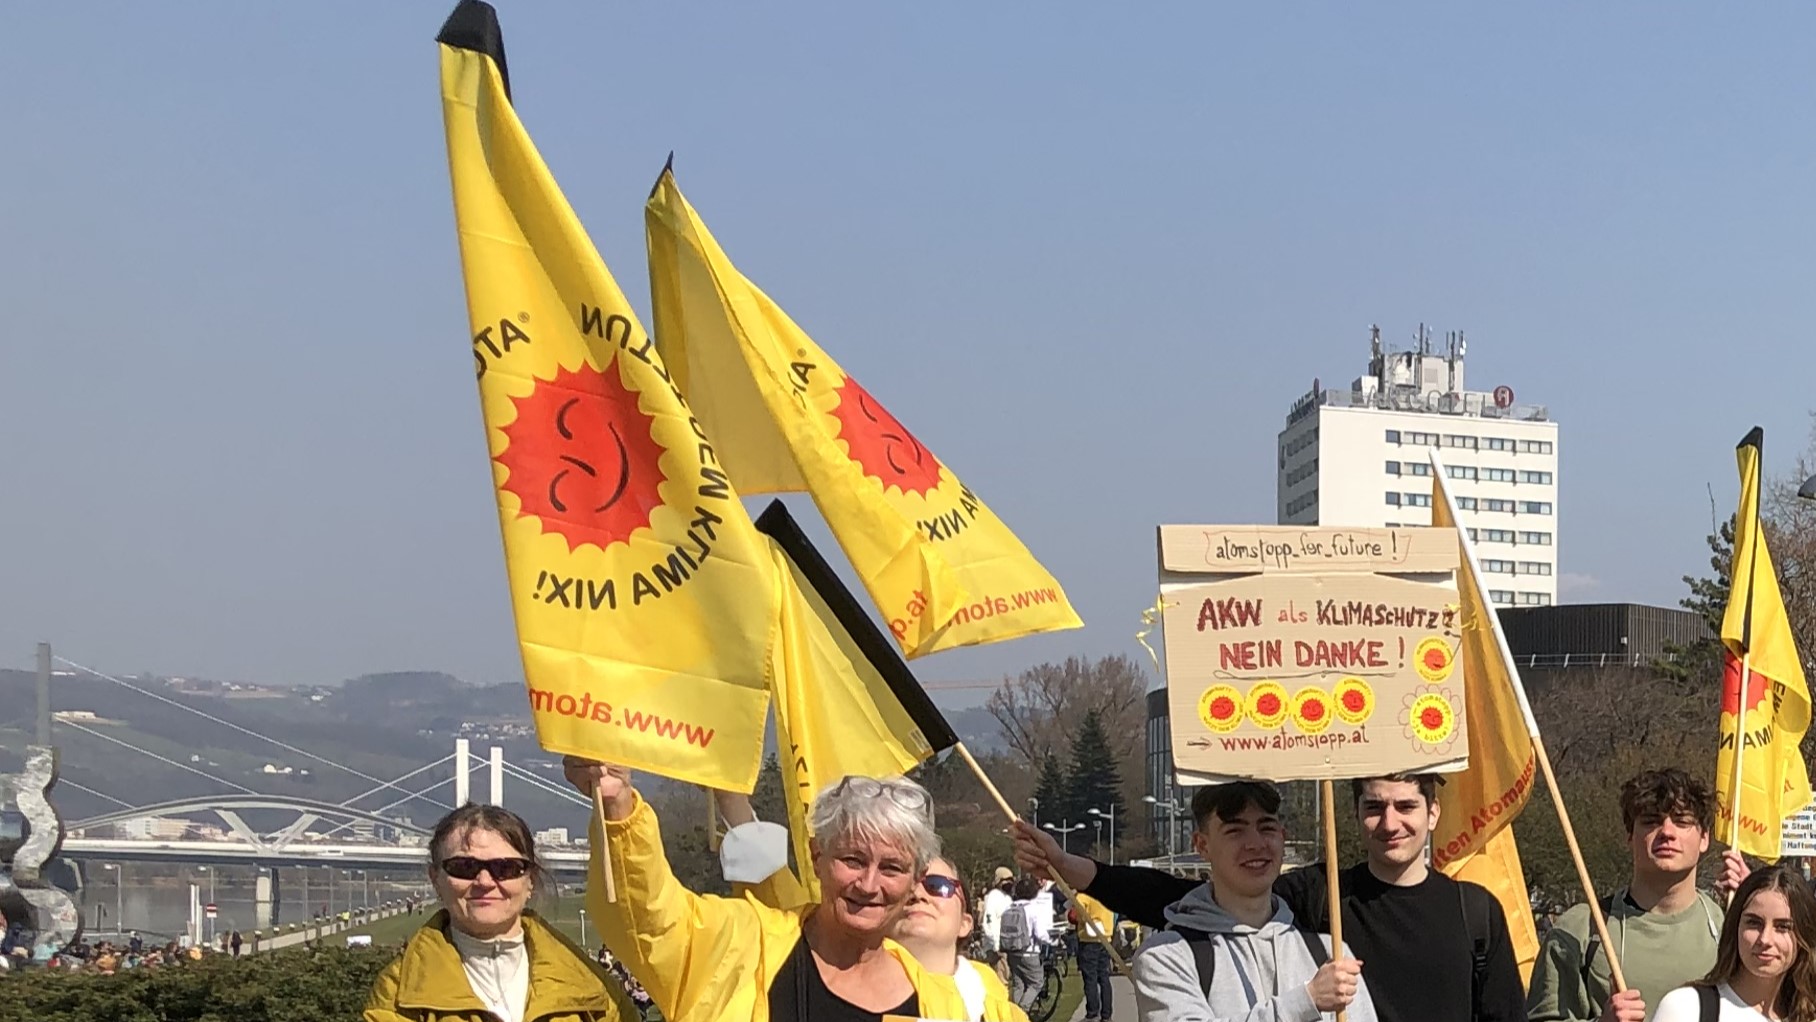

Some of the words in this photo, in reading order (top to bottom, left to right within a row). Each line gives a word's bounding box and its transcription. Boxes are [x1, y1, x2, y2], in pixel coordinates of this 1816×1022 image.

[1196, 597, 1262, 632] AKW
[1277, 600, 1309, 625] als
[1219, 638, 1282, 670] NEIN
[1219, 723, 1370, 751] www.atomstopp.at
